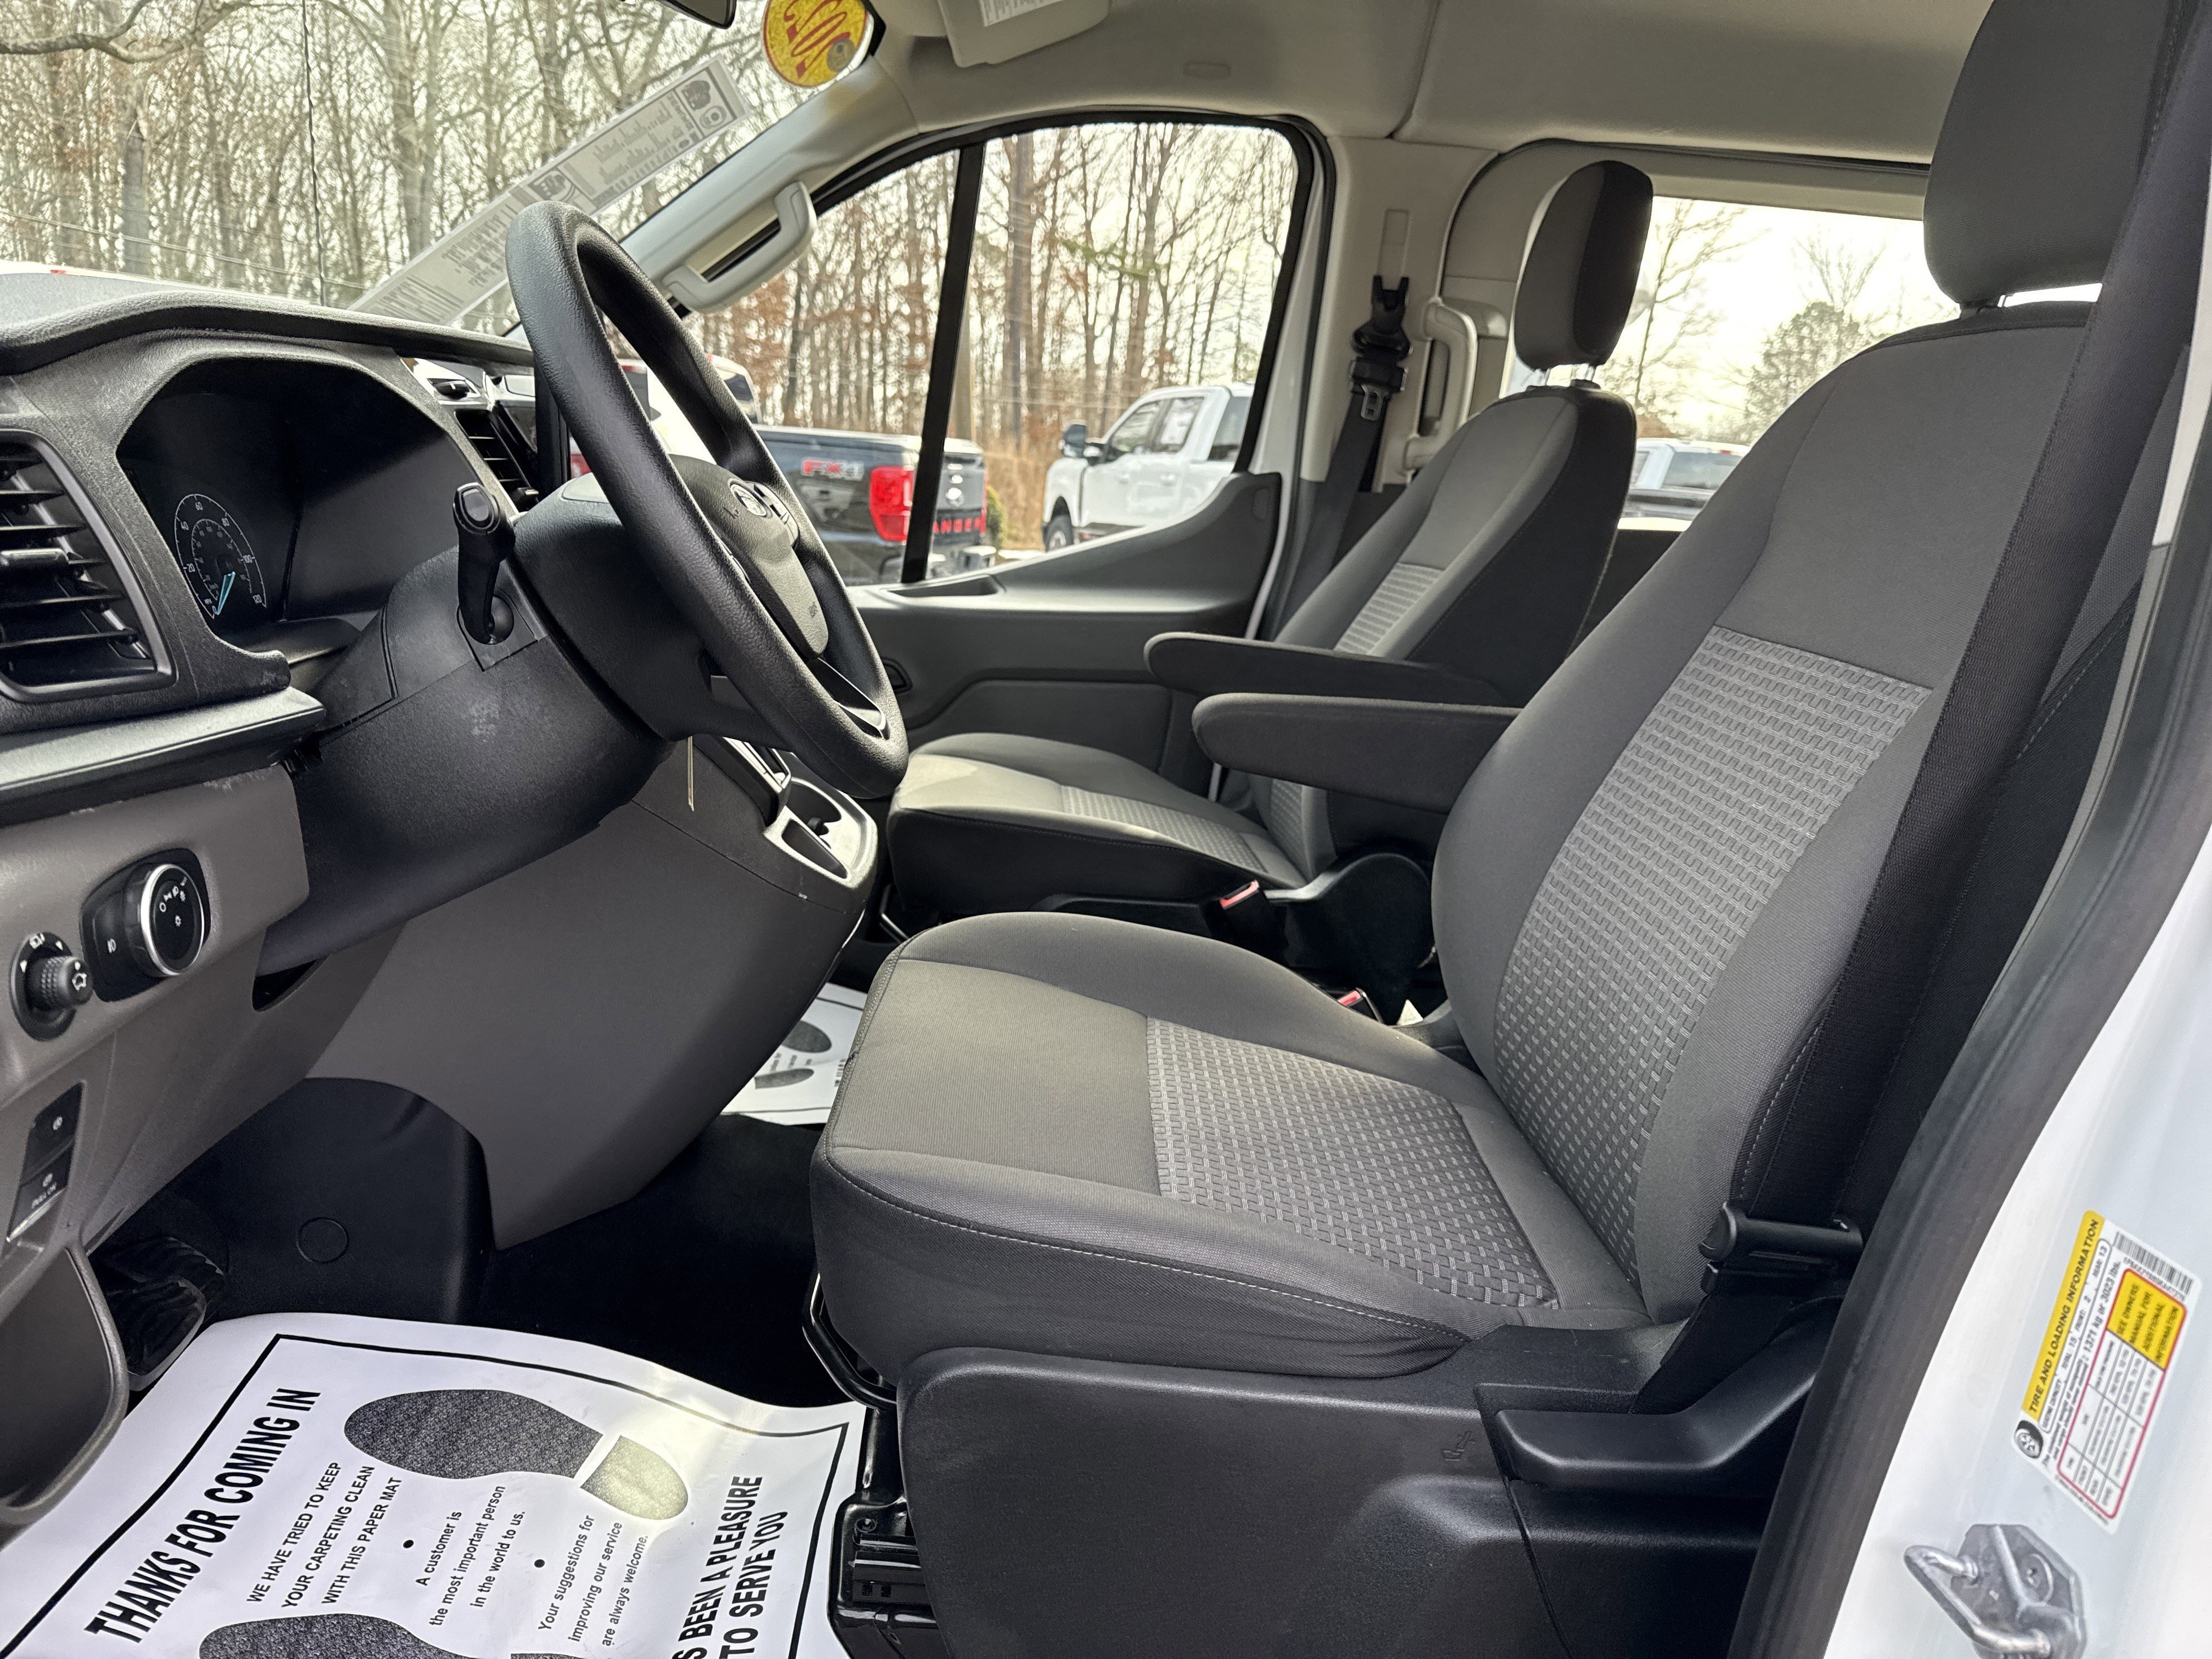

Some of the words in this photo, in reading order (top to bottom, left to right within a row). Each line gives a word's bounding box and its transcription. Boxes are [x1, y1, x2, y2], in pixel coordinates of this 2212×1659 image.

[802, 458, 865, 480] FX4
[932, 517, 981, 534] ANGER
[2098, 1245, 2107, 1257] 13
[2108, 1261, 2120, 1277] lbs.
[2030, 1383, 2044, 1414] TIRE
[2040, 1358, 2052, 1385] AND
[2048, 1304, 2069, 1357] LOADING
[2066, 1219, 2098, 1301] INFORMATION
[2097, 1302, 2105, 1314] or
[2100, 1276, 2114, 1303] 3023
[2084, 1328, 2097, 1353] 1371
[2091, 1314, 2103, 1329] kg
[2116, 1317, 2127, 1336] SEE
[84, 1551, 201, 1643] THANKS
[165, 1509, 241, 1558] FOR
[204, 1417, 300, 1503] COMING
[266, 1389, 321, 1411] IN
[247, 1584, 270, 1601] WE
[261, 1550, 292, 1581] HAVE
[283, 1514, 313, 1545] TRIED
[304, 1494, 324, 1509] TO
[316, 1463, 341, 1491] KEEP
[281, 1576, 314, 1607] YOUR
[306, 1506, 352, 1571] CARPETING
[345, 1466, 374, 1502] CLEAN
[321, 1576, 350, 1604] WITH
[341, 1546, 365, 1570] THIS
[357, 1505, 388, 1542] PAPER
[380, 1477, 402, 1500] MAT
[425, 1523, 455, 1573] customer
[447, 1512, 462, 1521] is
[706, 1476, 762, 1566] PLEASURE
[749, 1512, 788, 1551] YOU
[429, 1609, 448, 1625] the
[442, 1576, 464, 1604] most
[453, 1523, 488, 1572] important
[482, 1487, 505, 1520] person
[470, 1598, 486, 1607] in
[478, 1576, 495, 1592] the
[489, 1543, 510, 1571] world
[502, 1530, 516, 1538] to
[510, 1511, 525, 1526] us.
[538, 1603, 559, 1629] Your
[555, 1534, 587, 1600] suggestions
[579, 1516, 594, 1530] for
[568, 1585, 601, 1641] improving
[594, 1563, 607, 1581] our
[602, 1523, 622, 1560] service
[701, 1566, 733, 1582] A
[729, 1549, 776, 1617] SERVE
[602, 1629, 615, 1646] are
[609, 1588, 629, 1624] always
[624, 1535, 648, 1583] welcome.
[678, 1585, 726, 1642] BEEN
[719, 1628, 758, 1659] TO
